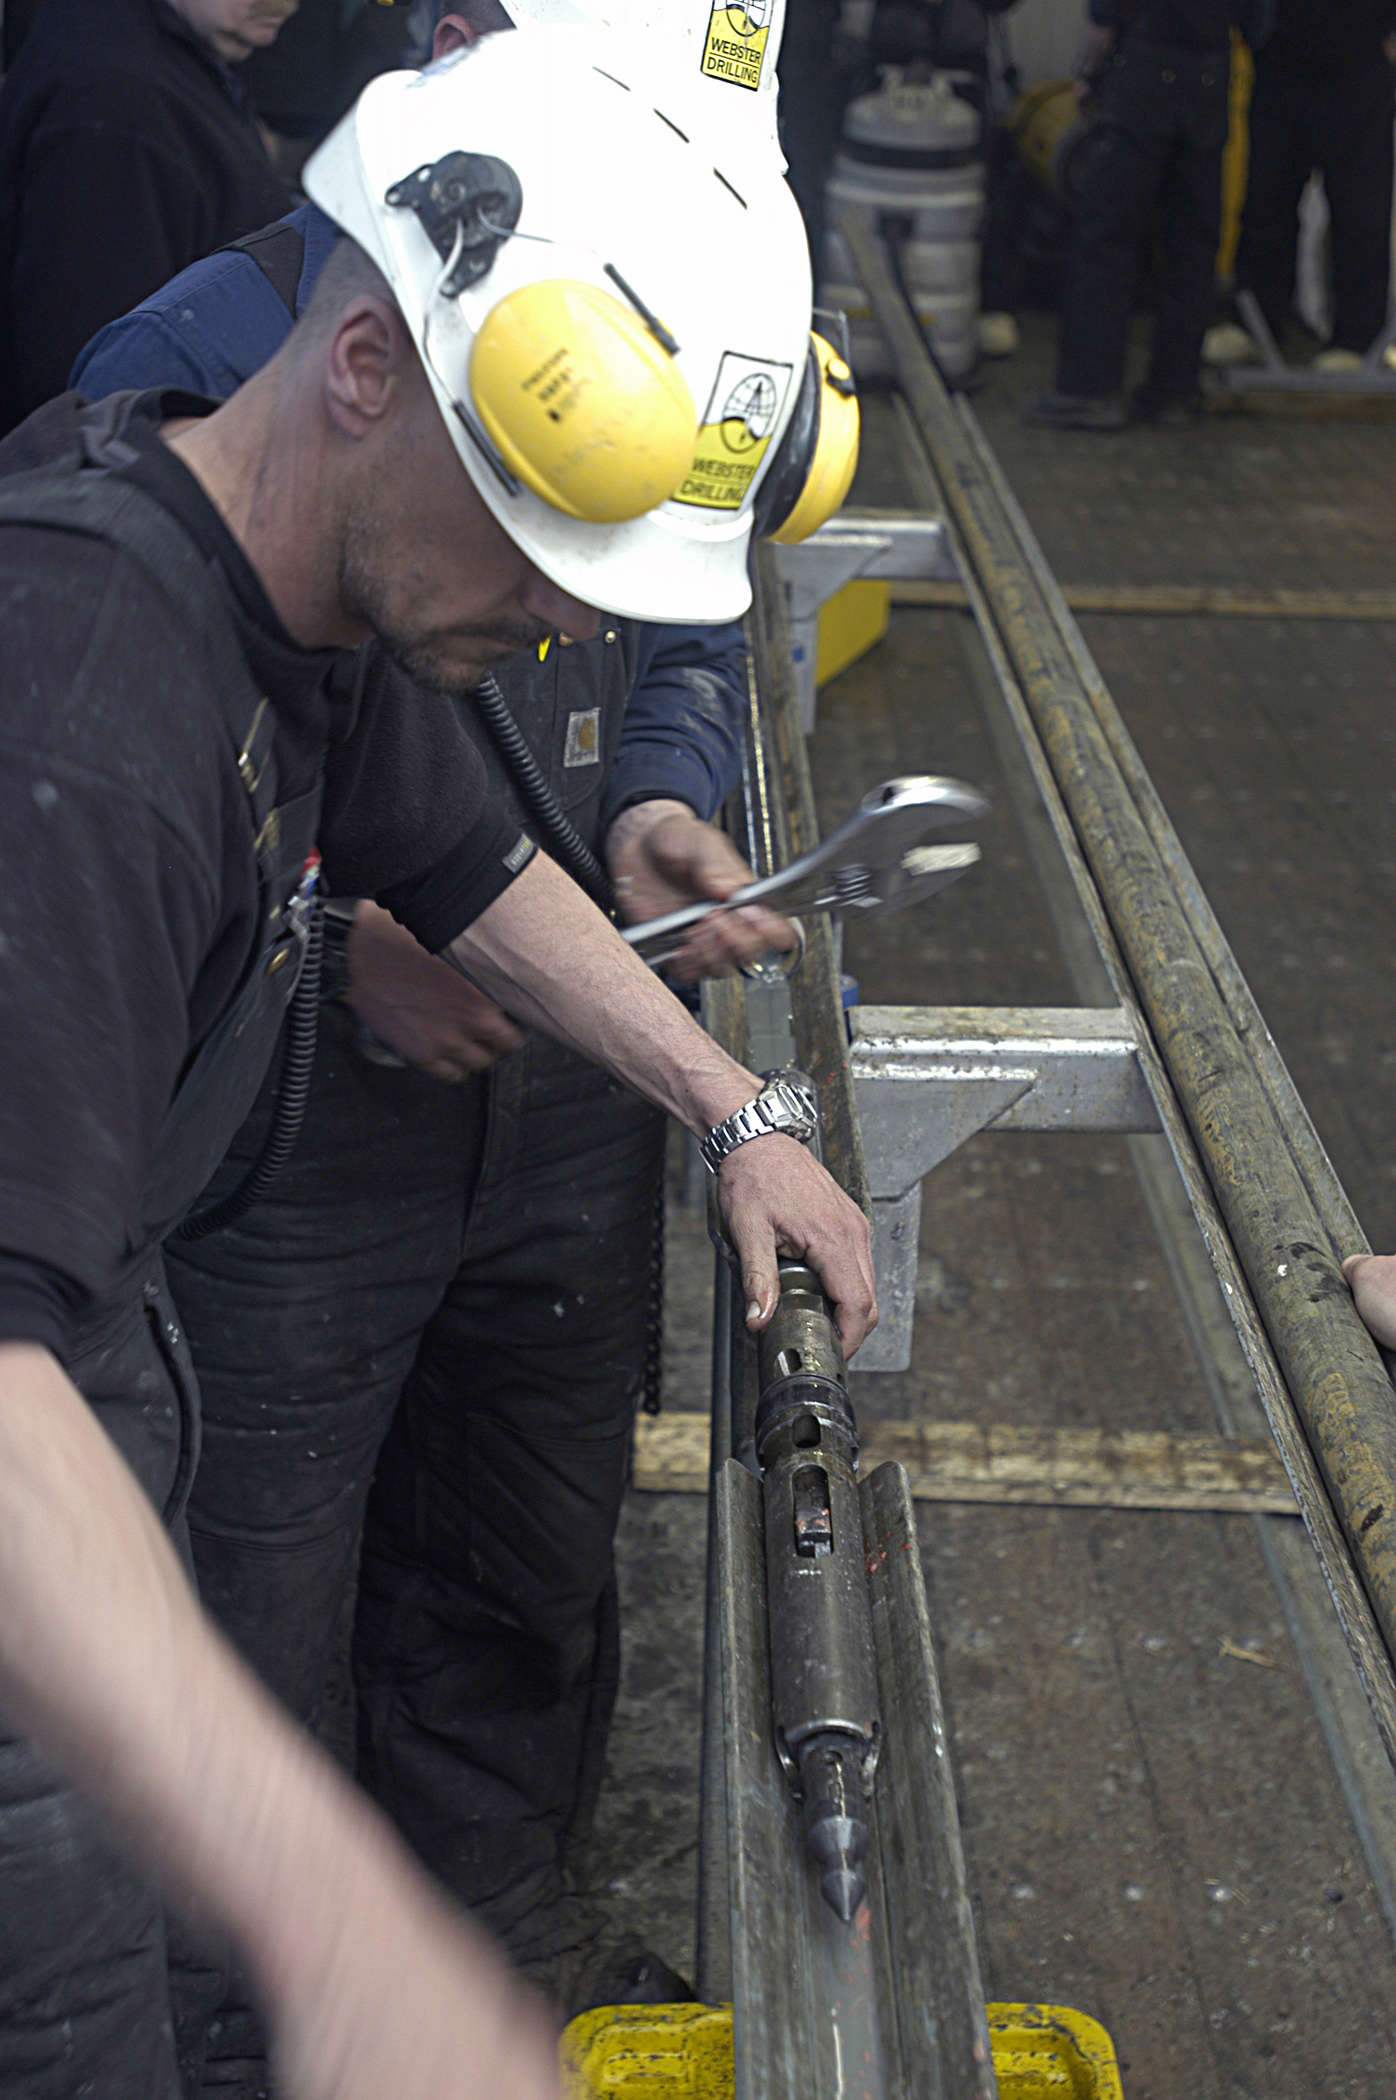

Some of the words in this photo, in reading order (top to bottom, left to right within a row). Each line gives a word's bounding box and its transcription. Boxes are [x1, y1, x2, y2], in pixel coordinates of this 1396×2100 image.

[711, 36, 761, 64] WEBSTER
[706, 56, 759, 83] DRILLING
[692, 457, 756, 480] WEBSTER
[680, 479, 744, 503] DRILLING
